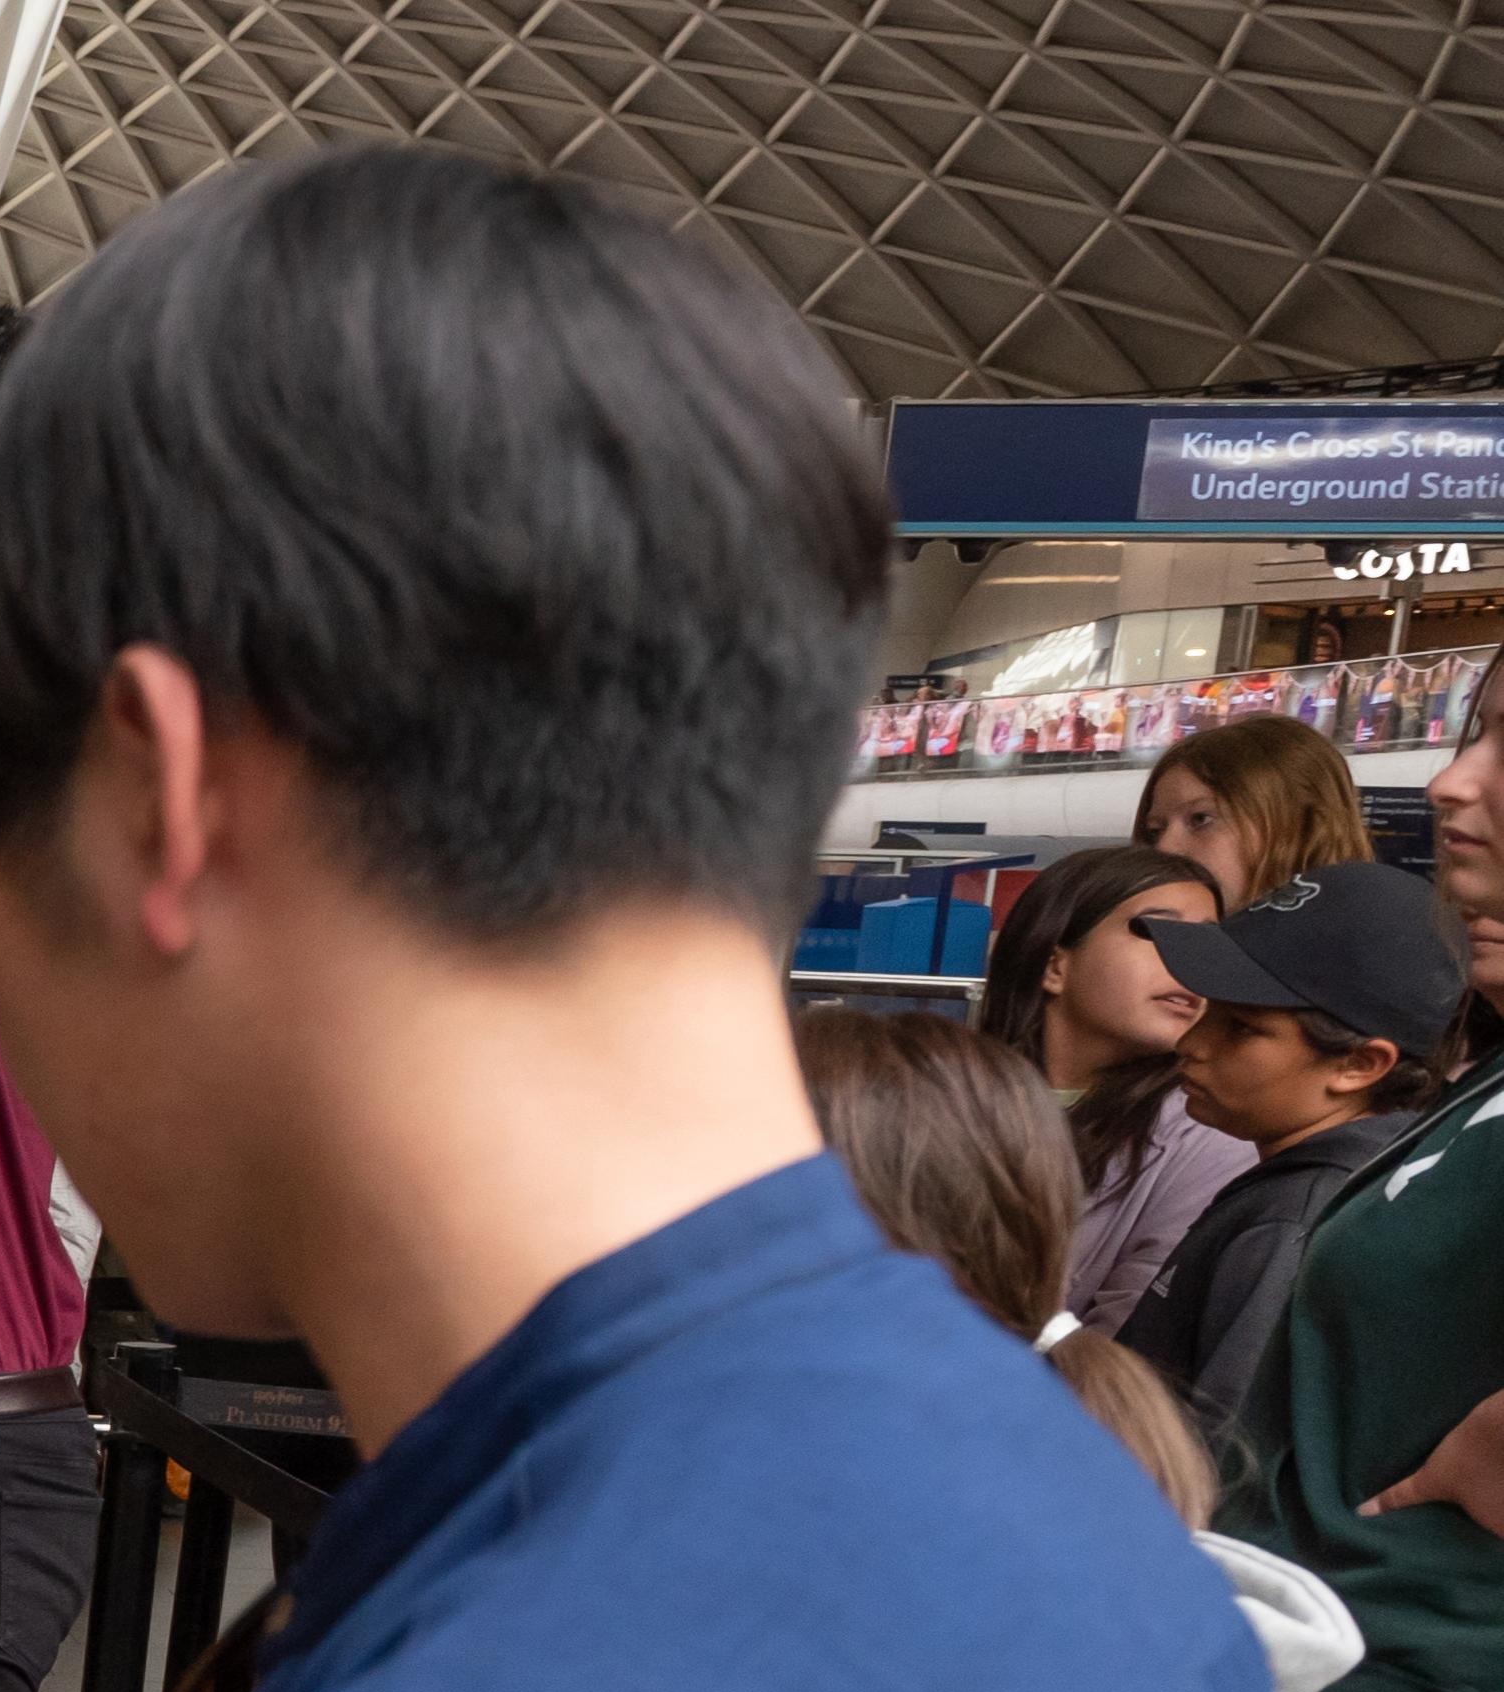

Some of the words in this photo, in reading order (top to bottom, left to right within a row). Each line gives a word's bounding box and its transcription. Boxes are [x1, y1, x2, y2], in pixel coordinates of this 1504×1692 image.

[1181, 431, 1276, 465] King's
[1287, 431, 1379, 459] Cross
[1388, 431, 1425, 458] St
[1191, 473, 1410, 506] Underground
[1419, 473, 1504, 499] Stati
[226, 1406, 321, 1431] PLATFORM
